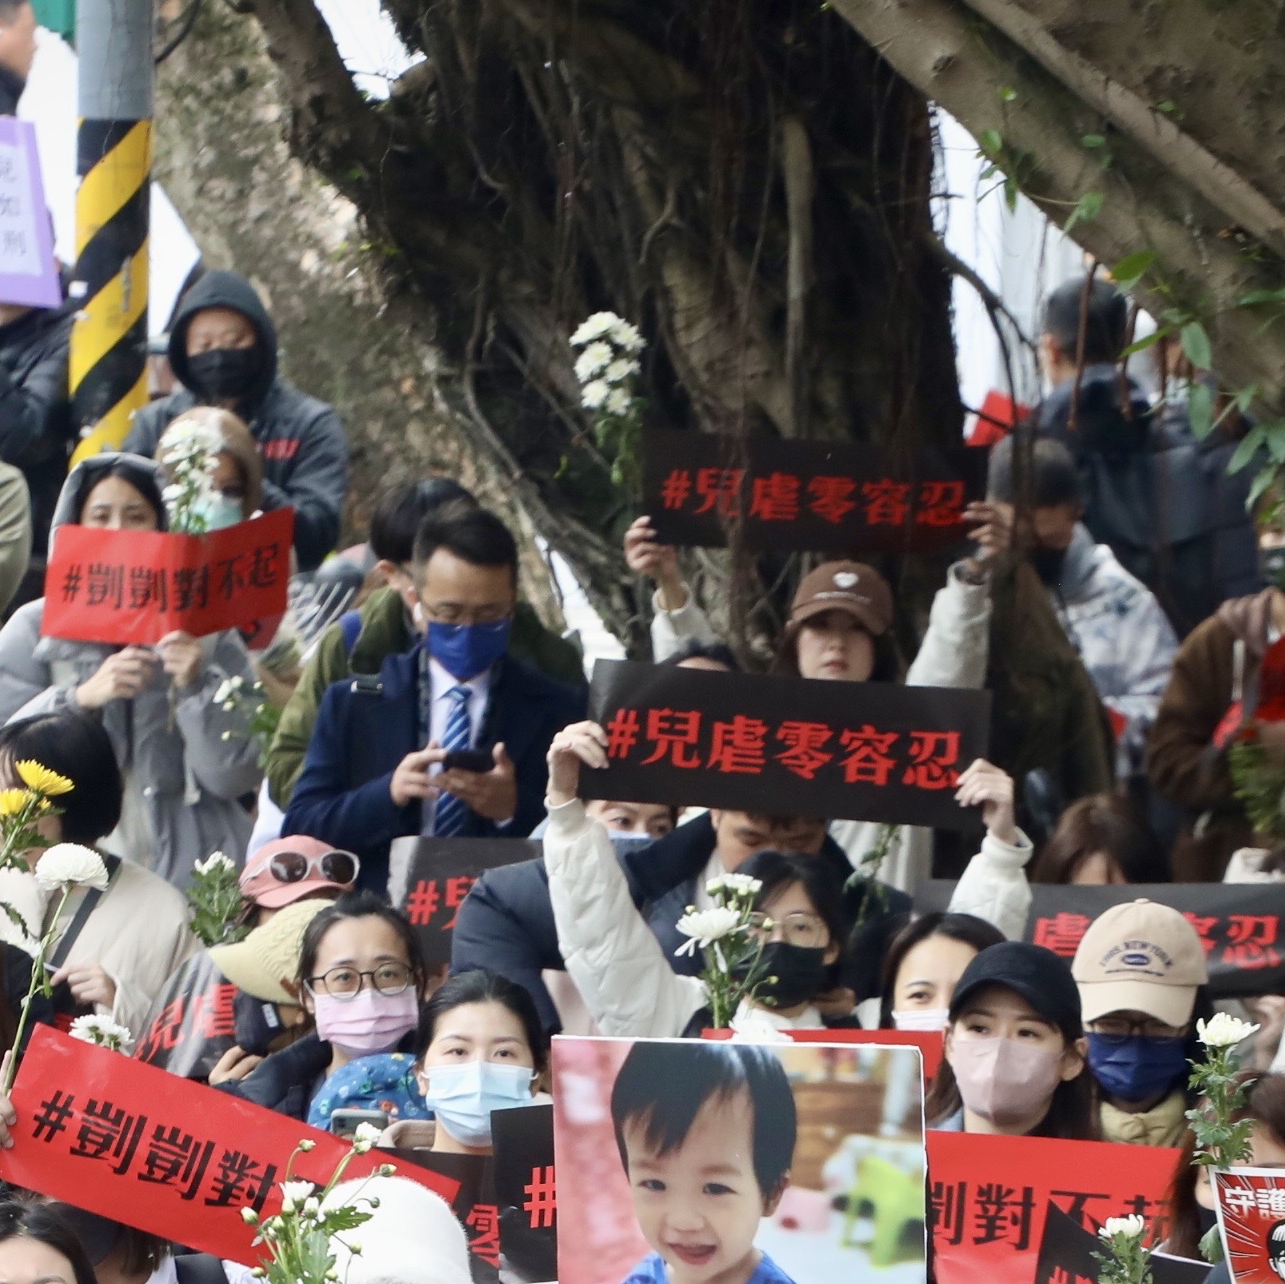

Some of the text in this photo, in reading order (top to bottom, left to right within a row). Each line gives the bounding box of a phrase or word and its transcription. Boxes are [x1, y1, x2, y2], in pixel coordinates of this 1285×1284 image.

[661, 468, 966, 527] #兒虐零容忍
[62, 543, 278, 616] #剴剴對不起
[607, 707, 963, 790] #兒虐零容忍
[32, 1089, 328, 1218] #剴剴對
